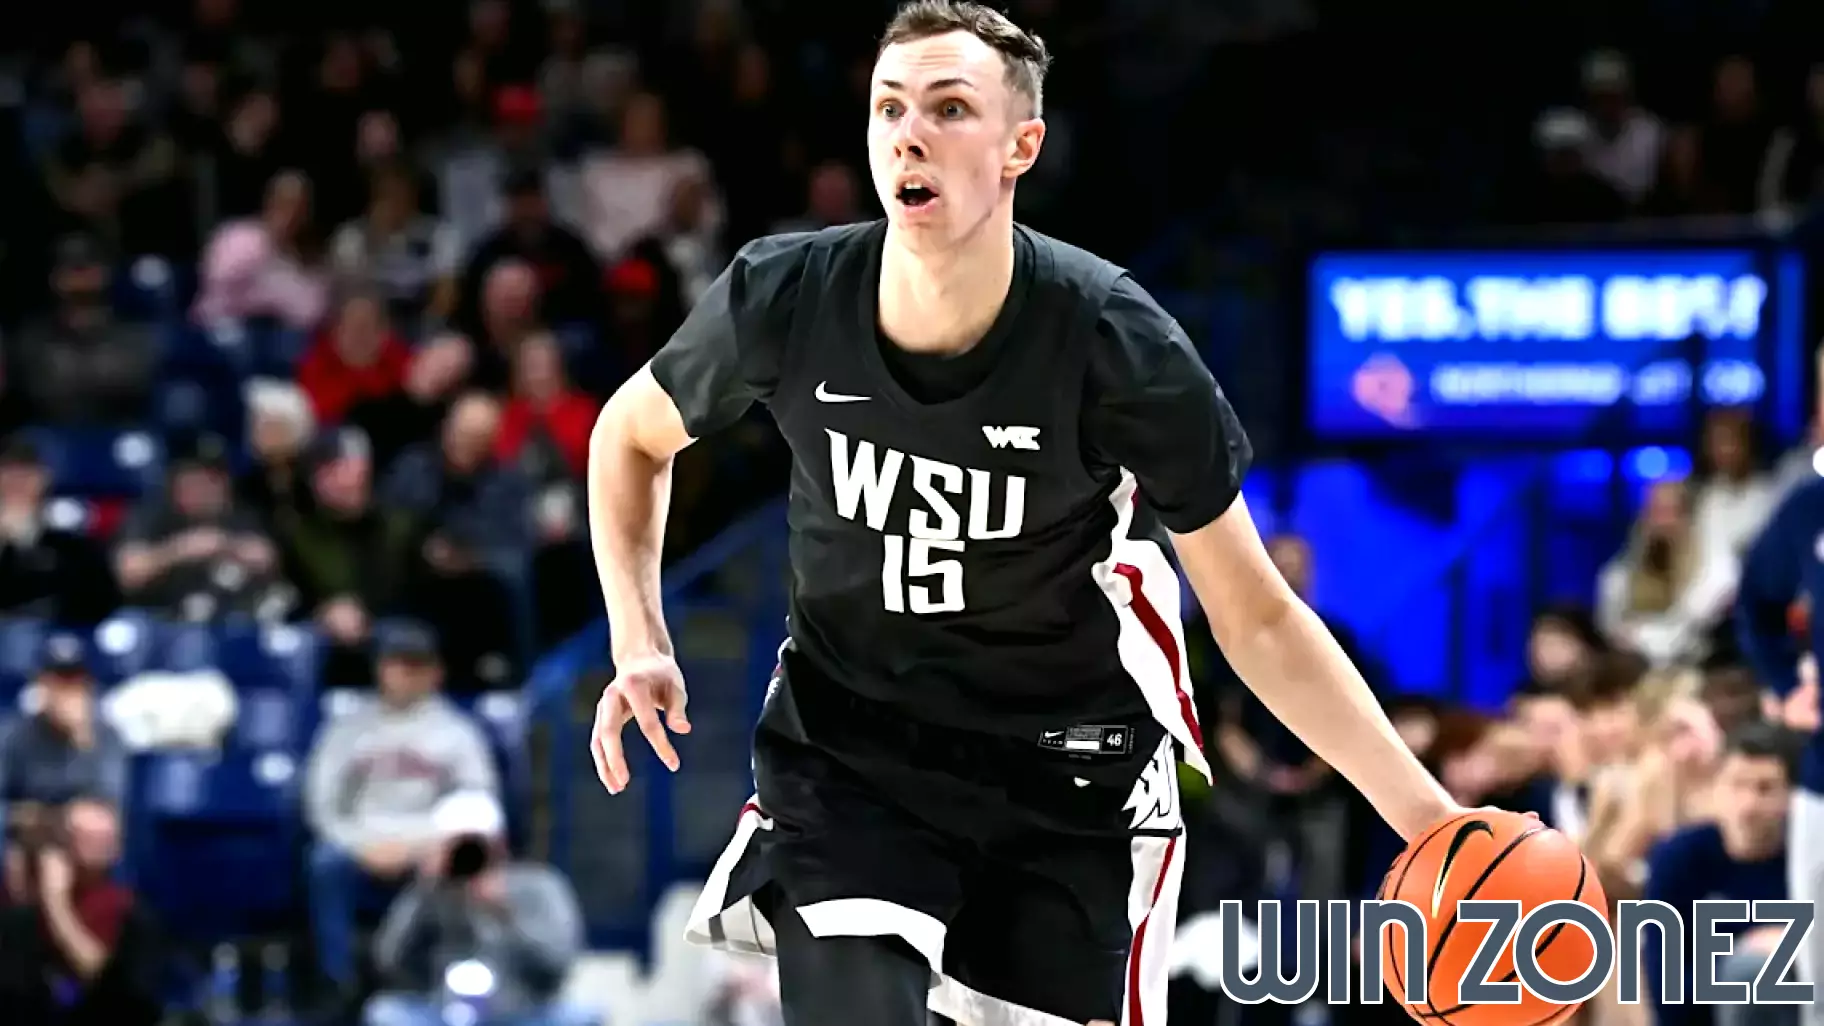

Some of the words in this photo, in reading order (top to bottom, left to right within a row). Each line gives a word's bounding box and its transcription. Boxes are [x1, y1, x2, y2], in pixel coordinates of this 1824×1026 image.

[824, 427, 1026, 541] WSU
[882, 534, 965, 614] 15
[1106, 733, 1123, 747] 46
